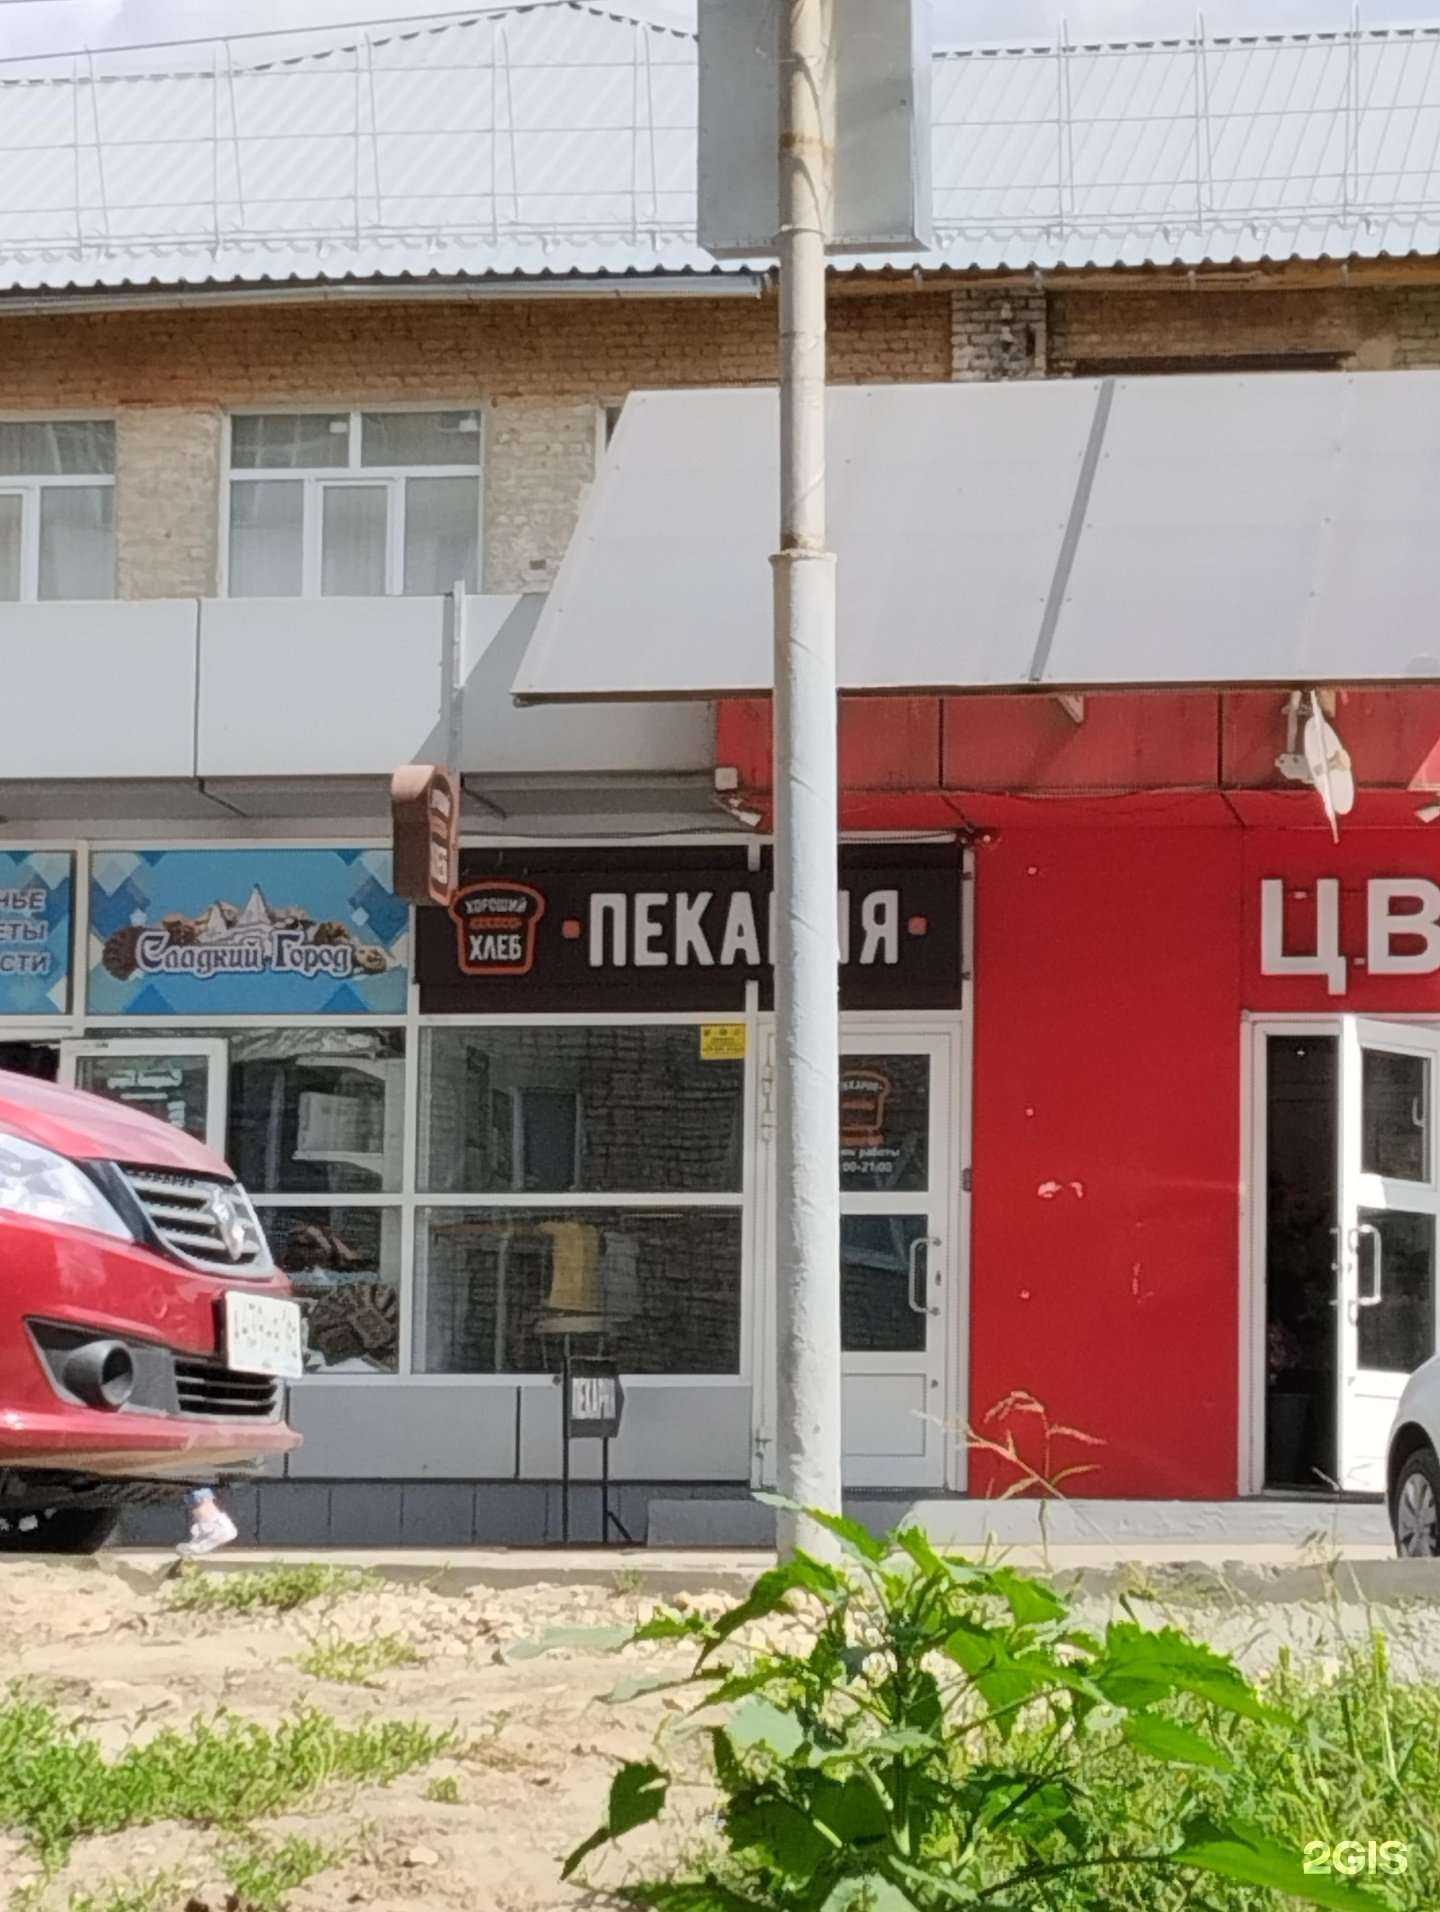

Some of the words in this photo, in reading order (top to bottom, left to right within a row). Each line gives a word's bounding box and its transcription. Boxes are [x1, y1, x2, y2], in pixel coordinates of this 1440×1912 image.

[271, 931, 351, 977] Город
[468, 934, 522, 961] ХЛЕБ
[588, 890, 899, 967] ПЕКАЯ
[1261, 878, 1440, 995] ЦВ
